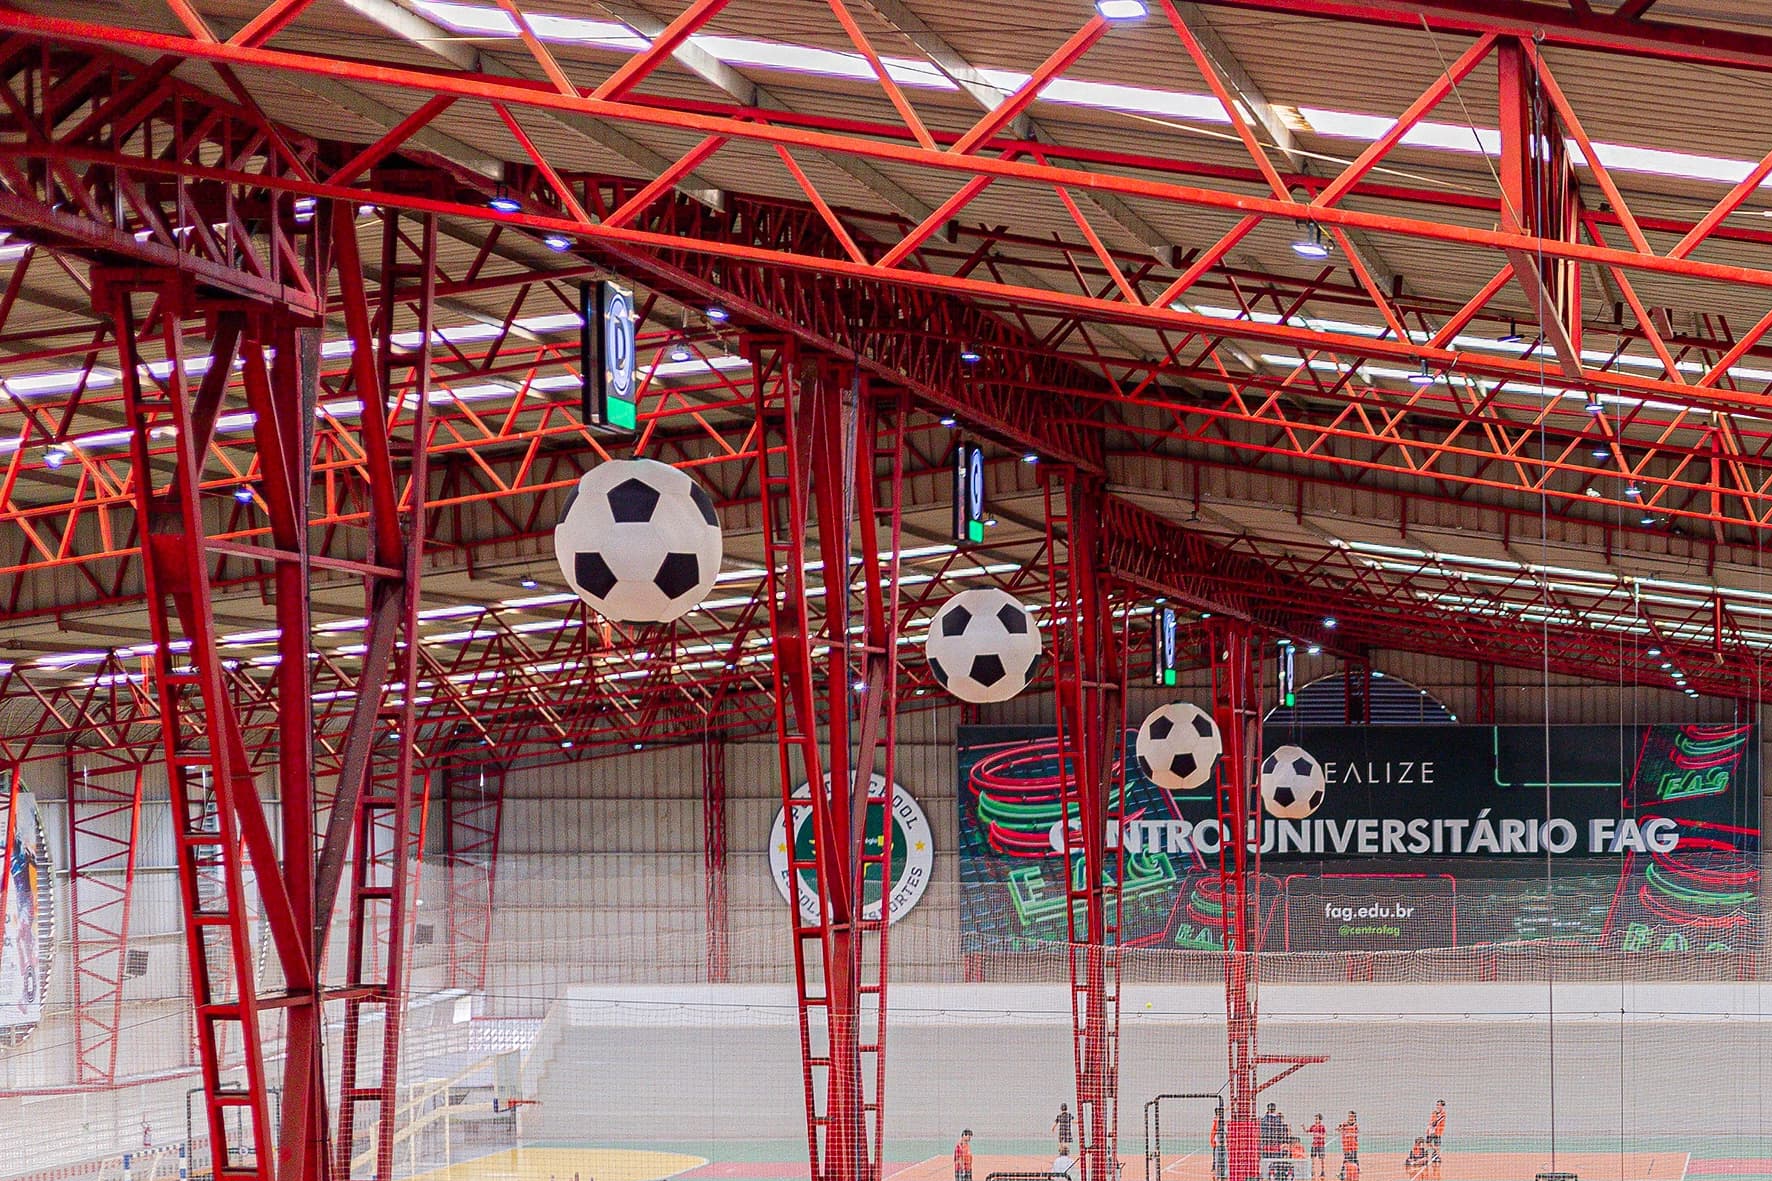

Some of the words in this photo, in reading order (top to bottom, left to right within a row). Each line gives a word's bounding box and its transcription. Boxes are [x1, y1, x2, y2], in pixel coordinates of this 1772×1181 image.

[1324, 762, 1434, 783] EALIZE
[1049, 818, 1231, 854] CNTRO
[1247, 808, 1577, 854] UNIVERSITÁRIO
[1589, 818, 1679, 853] FAG
[1325, 902, 1414, 921] fag.edu.br
[1339, 924, 1400, 937] @centrofag
